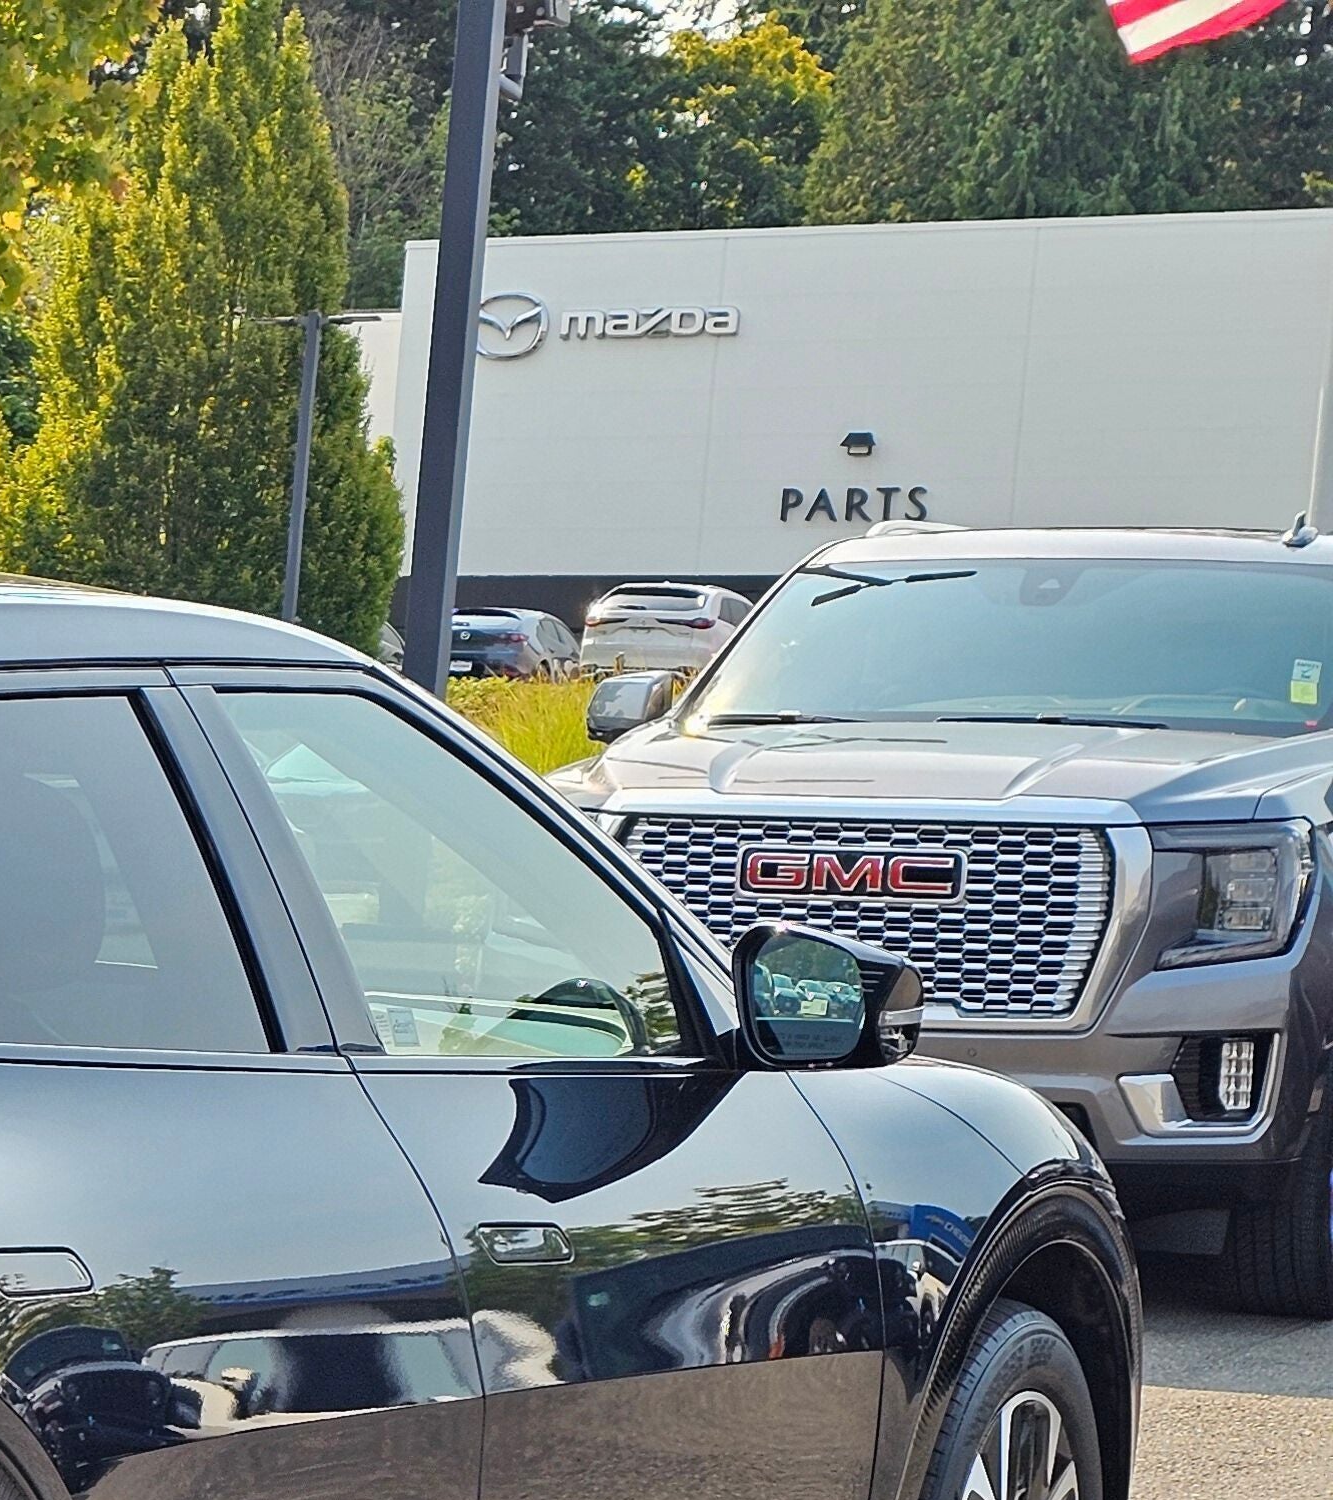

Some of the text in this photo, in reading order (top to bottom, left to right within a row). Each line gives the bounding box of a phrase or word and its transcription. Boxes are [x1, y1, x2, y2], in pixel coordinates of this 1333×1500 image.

[559, 306, 741, 341] mazda
[779, 487, 929, 523] PARTS
[747, 852, 955, 894] GMC
